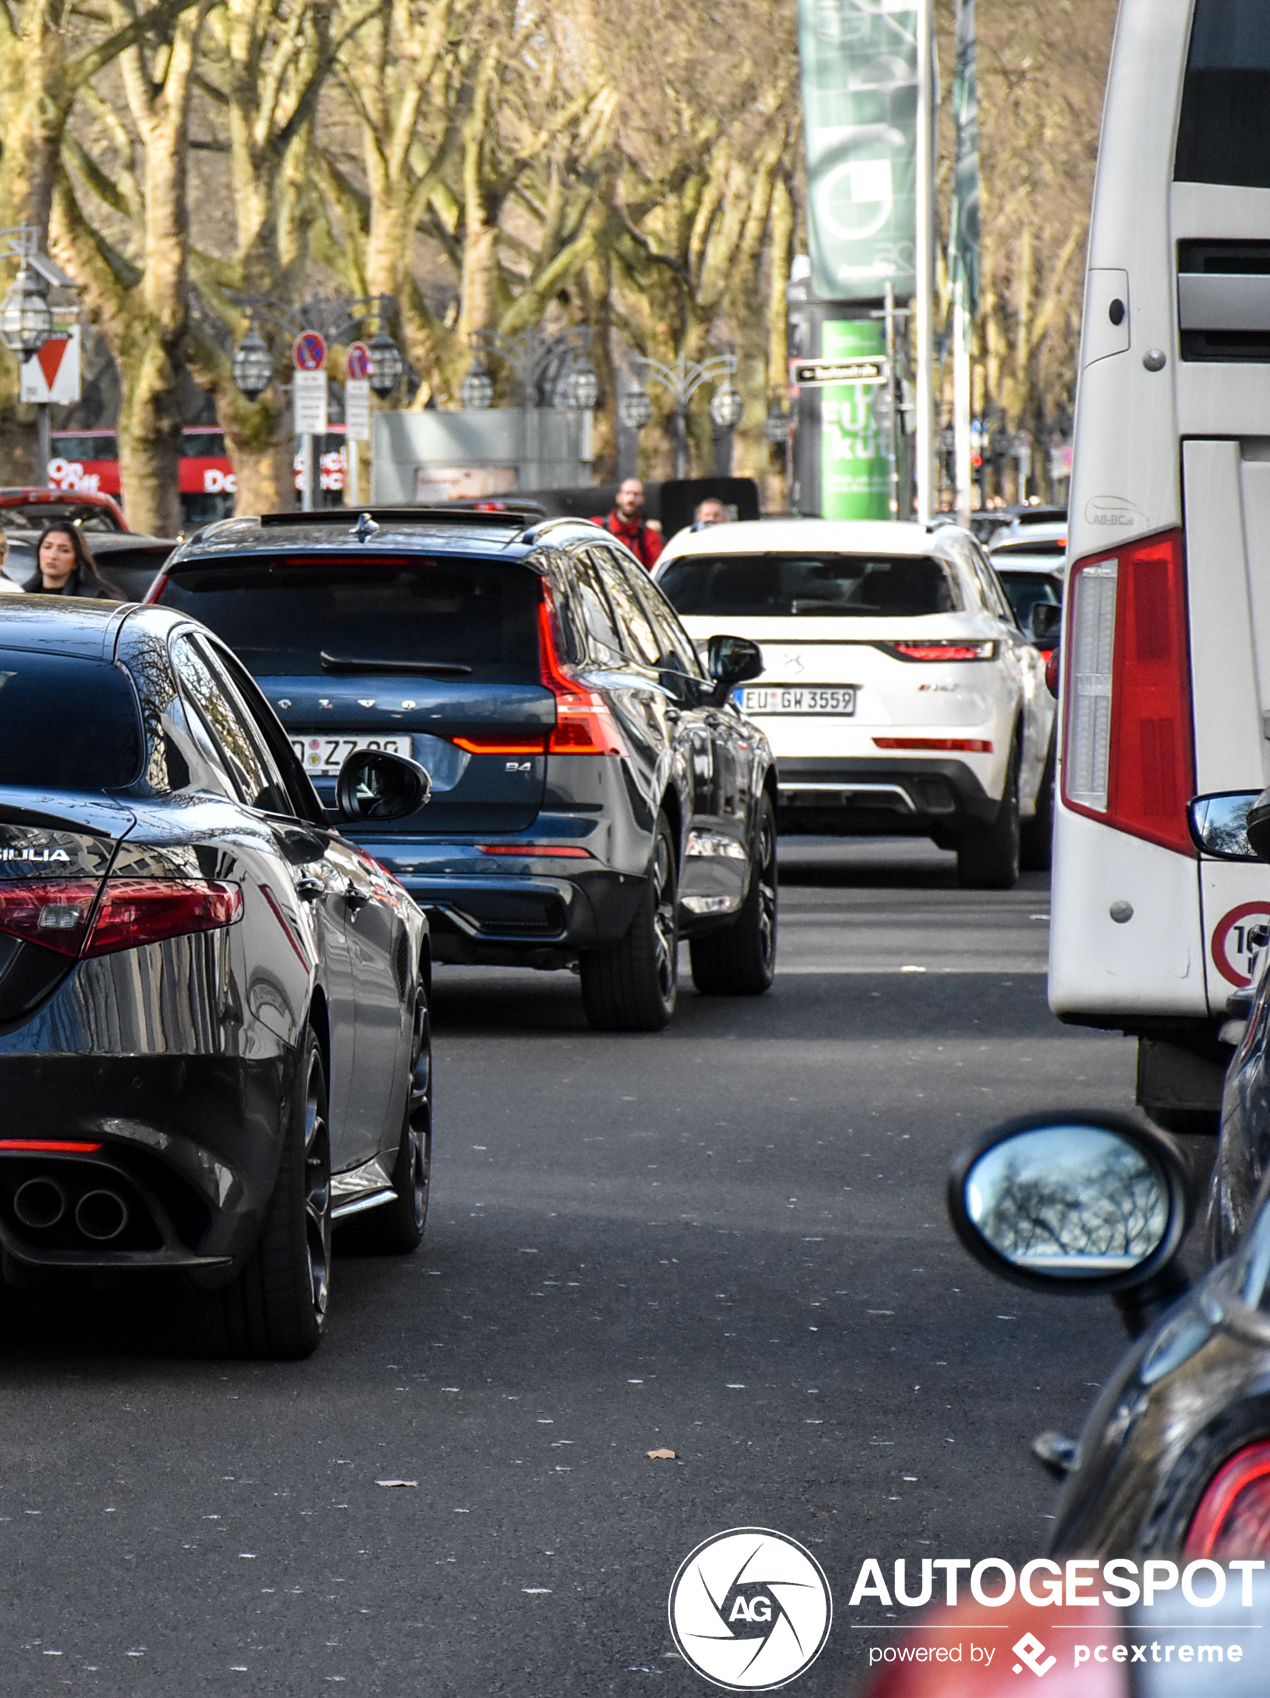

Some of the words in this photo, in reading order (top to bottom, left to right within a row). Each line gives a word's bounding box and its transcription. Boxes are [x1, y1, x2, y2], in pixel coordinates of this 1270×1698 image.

[48, 458, 83, 480] On
[746, 692, 767, 709] EU
[782, 692, 804, 709] GW
[808, 692, 852, 710] 3559
[504, 762, 532, 773] B4
